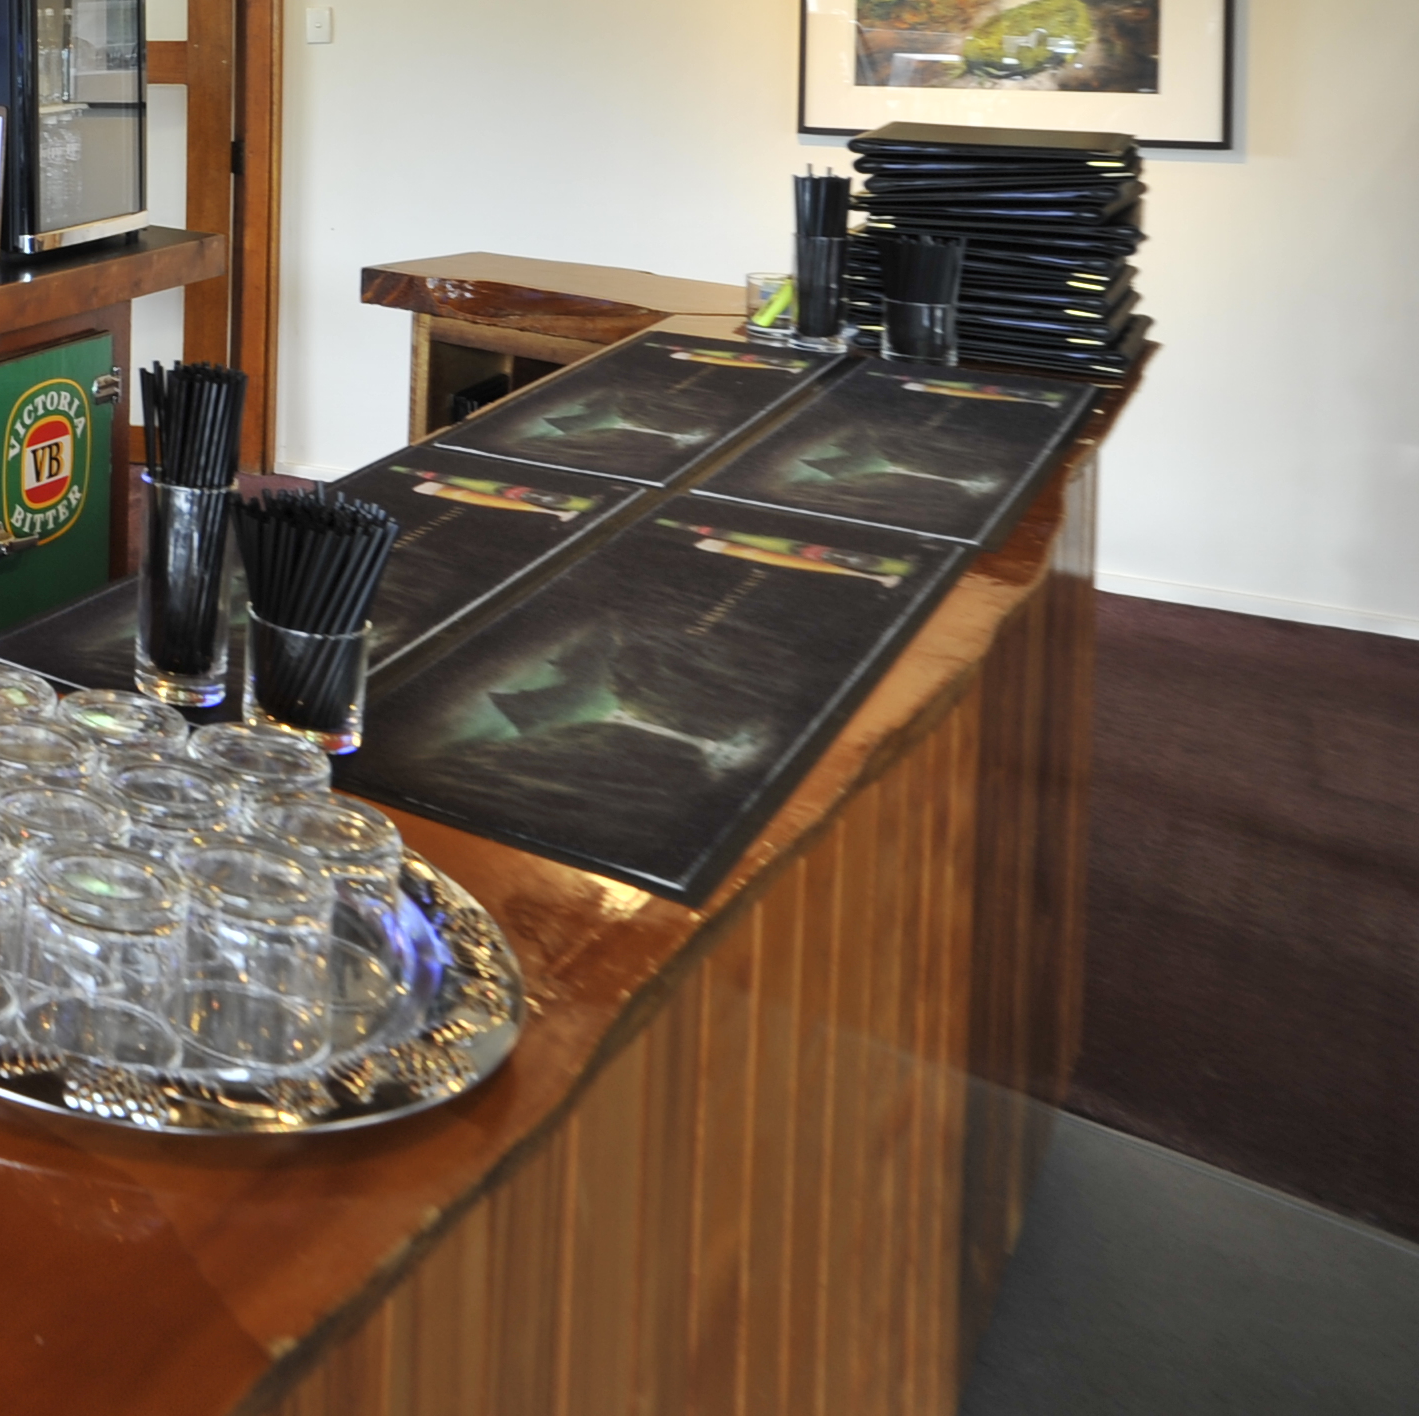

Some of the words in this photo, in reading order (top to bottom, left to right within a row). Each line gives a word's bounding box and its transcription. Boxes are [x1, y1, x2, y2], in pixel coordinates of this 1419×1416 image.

[8, 391, 86, 461] VICTORIA
[30, 440, 66, 483] VB
[11, 485, 82, 533] BITTER
